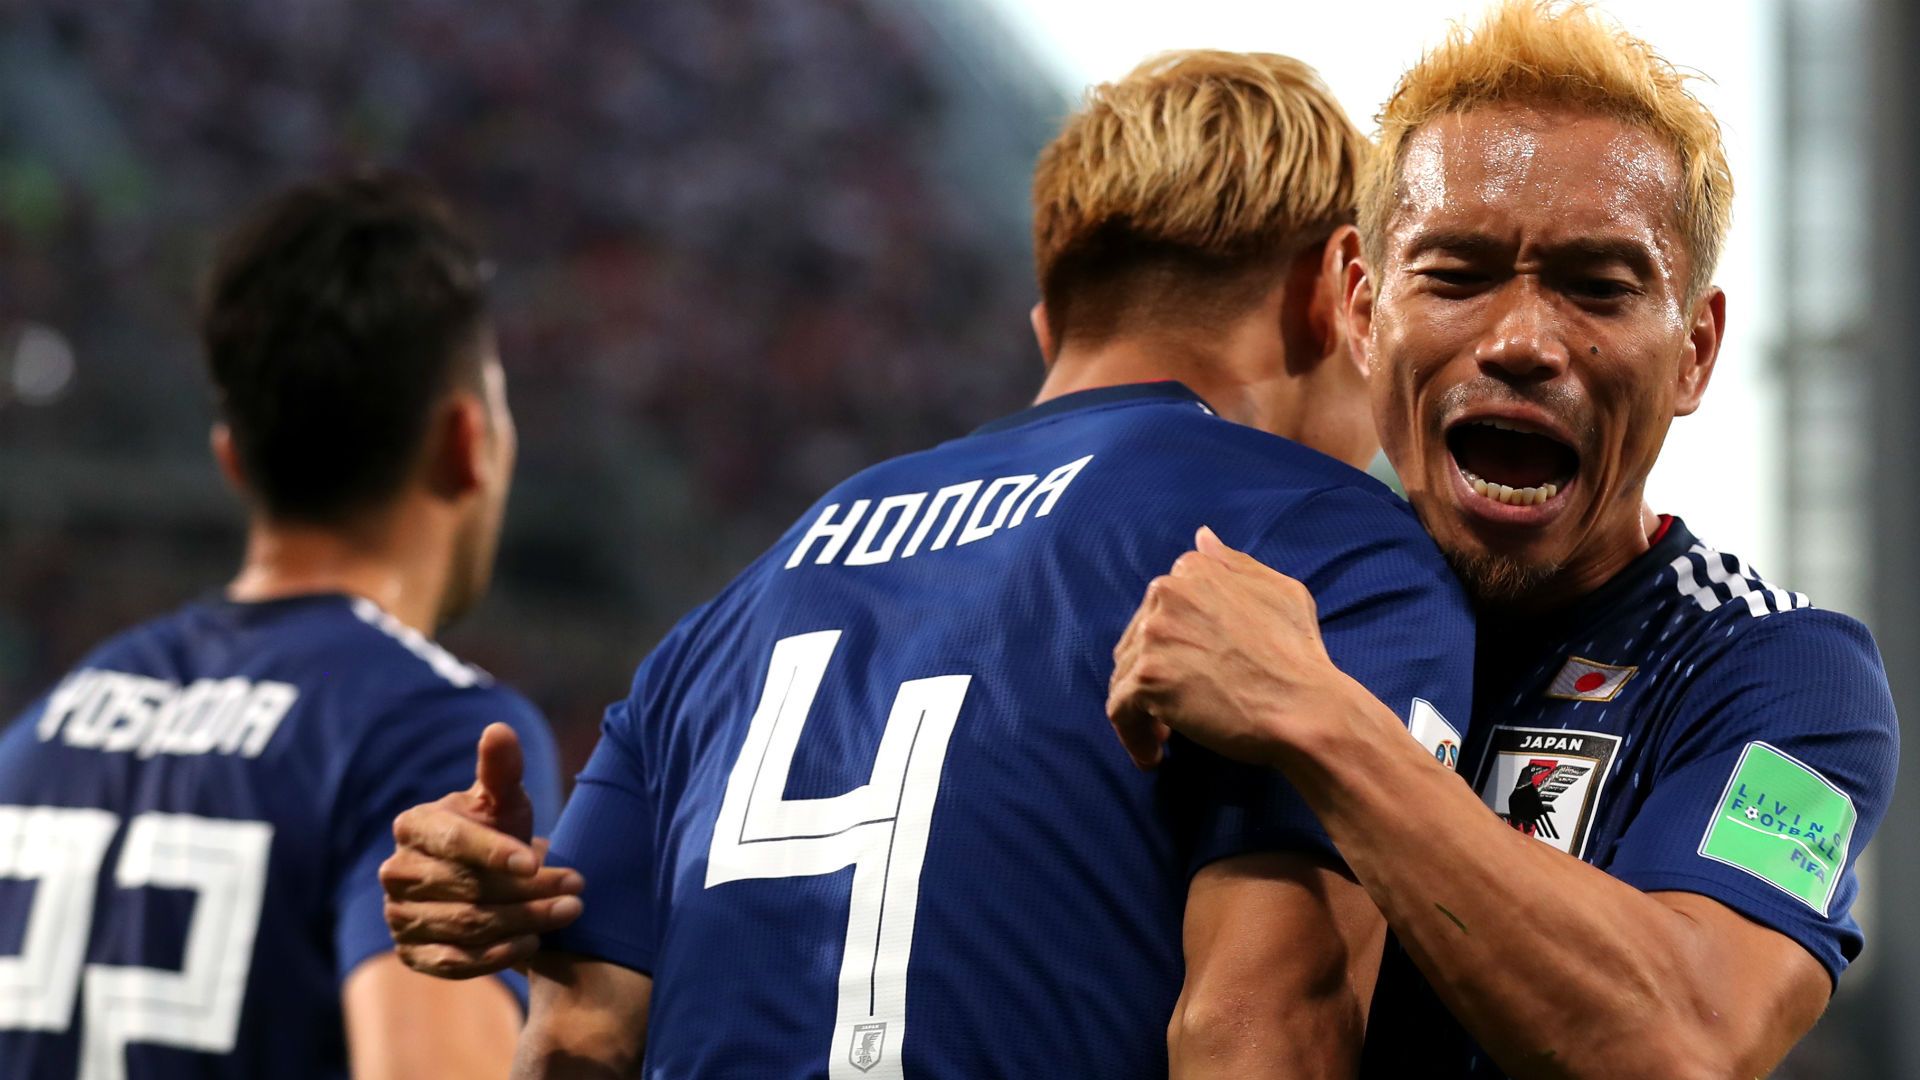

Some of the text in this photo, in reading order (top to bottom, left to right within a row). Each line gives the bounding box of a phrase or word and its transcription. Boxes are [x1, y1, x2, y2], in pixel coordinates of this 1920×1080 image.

[784, 454, 1095, 570] HONDA
[37, 667, 299, 760] YOSIDA
[1519, 735, 1584, 751] JAPAN
[704, 629, 972, 1080] 4
[1738, 784, 1842, 847] LIVING
[1790, 848, 1826, 885] FIFA
